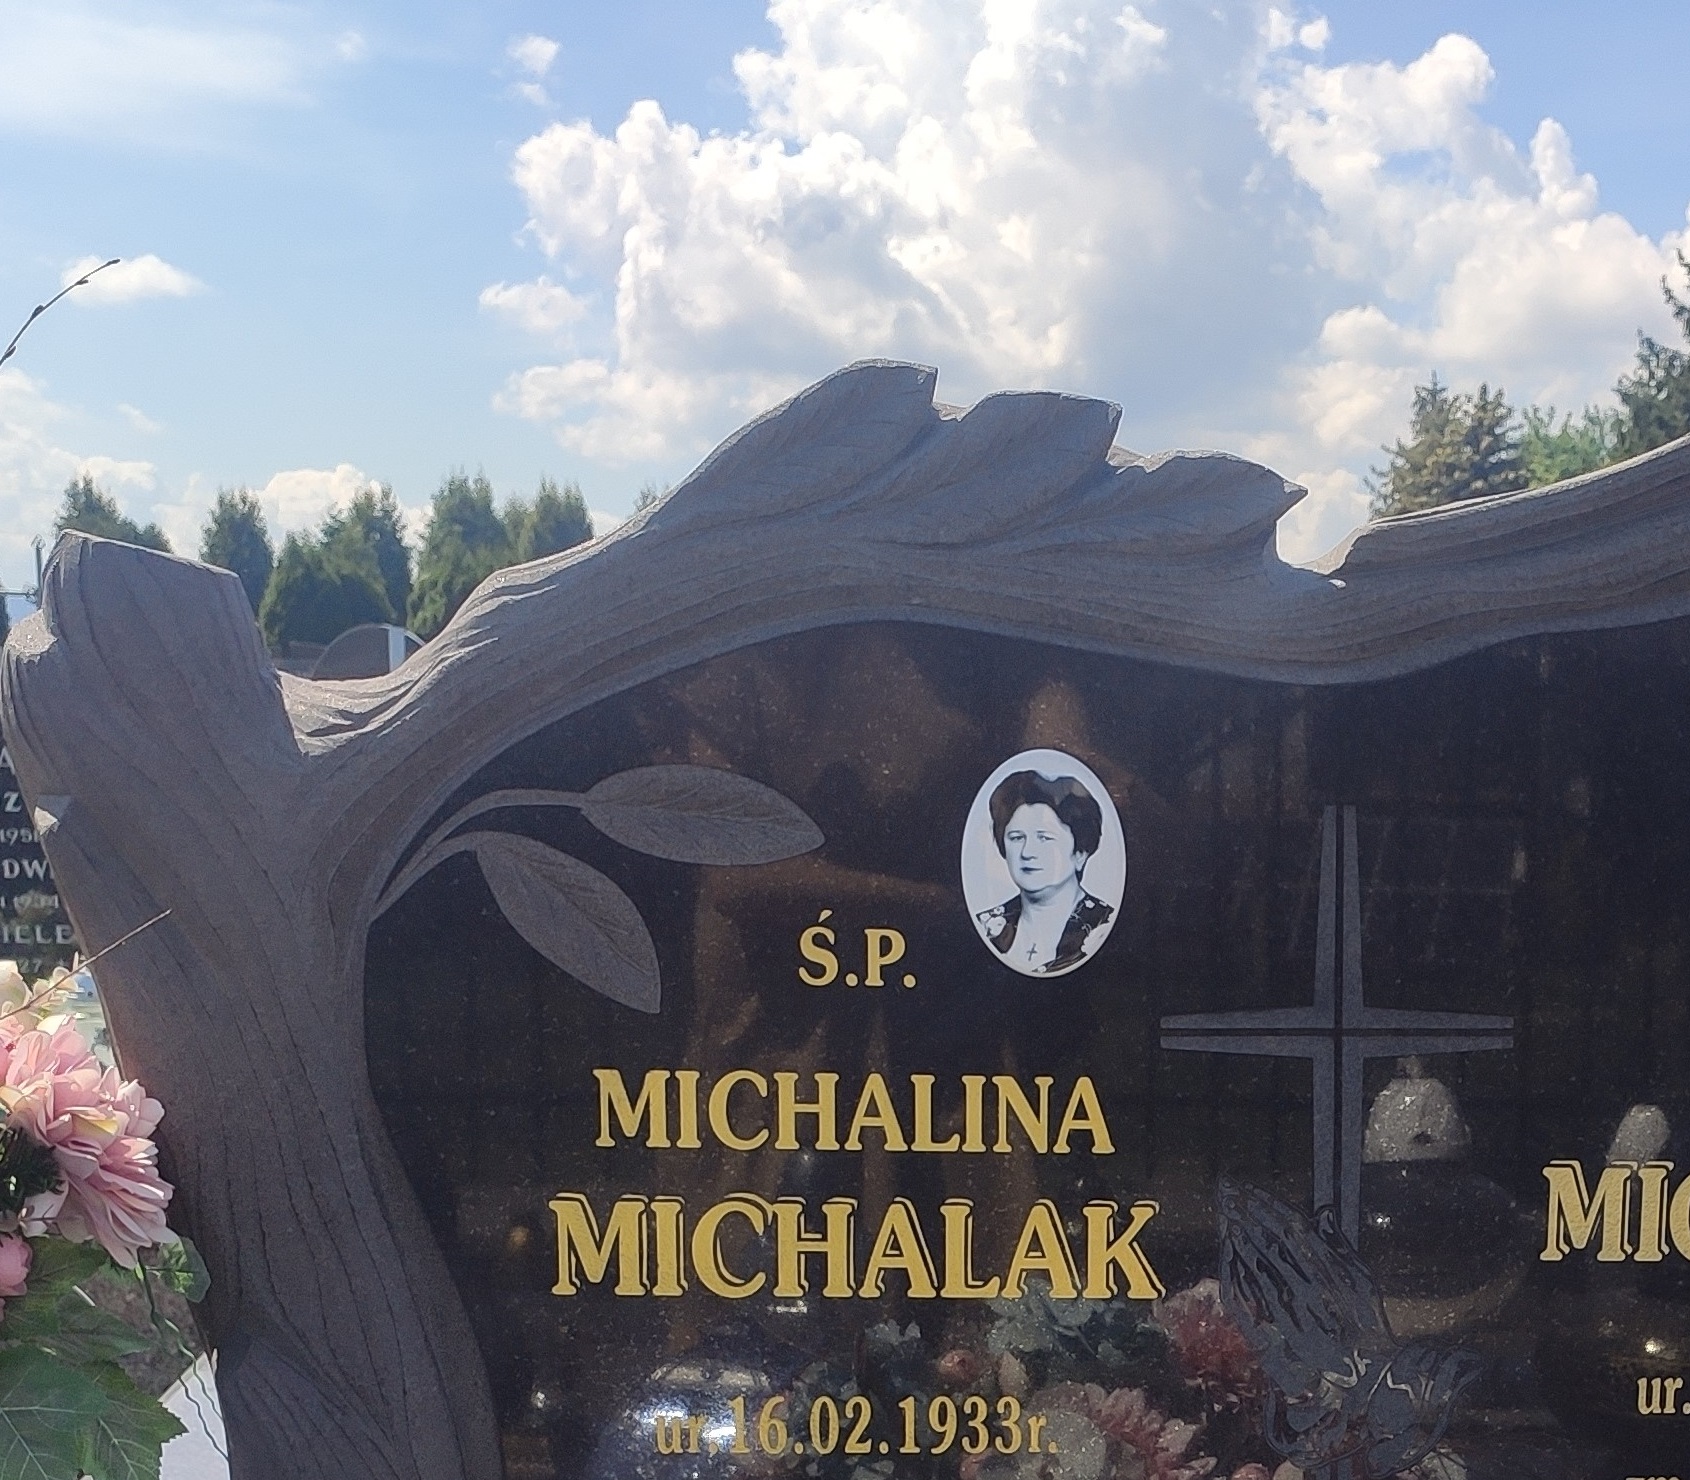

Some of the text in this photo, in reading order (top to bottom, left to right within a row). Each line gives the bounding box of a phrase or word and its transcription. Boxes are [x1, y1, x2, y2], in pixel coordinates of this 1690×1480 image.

[798, 909, 917, 988] Ś.P.
[592, 1069, 1115, 1154] MICHALINA
[548, 1193, 1165, 1299] MICHALAK
